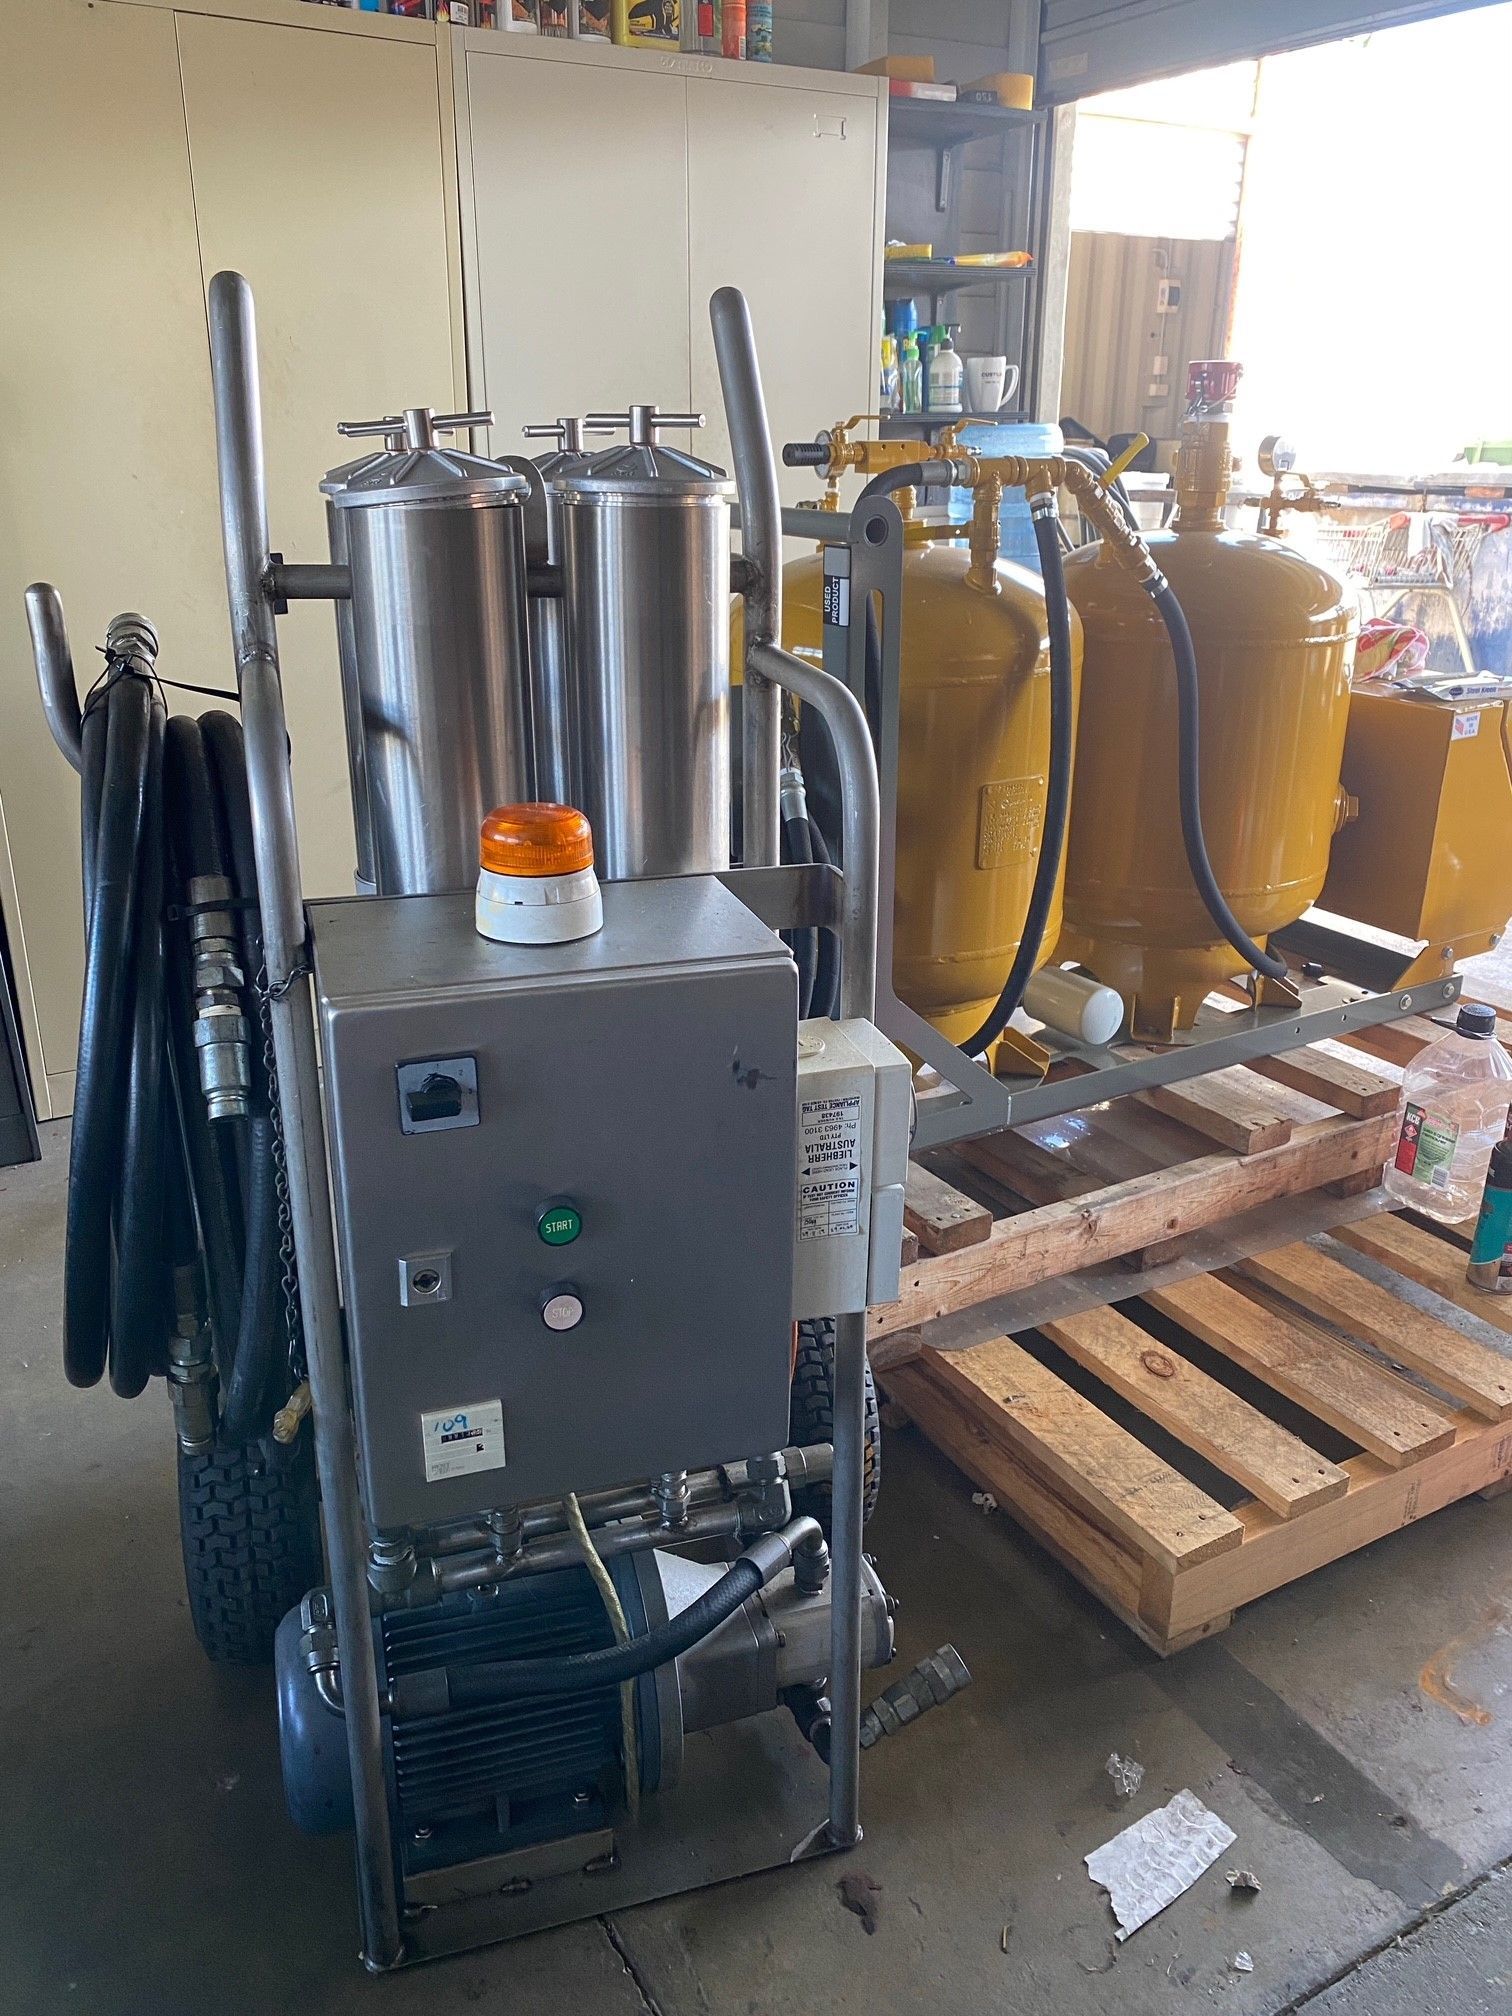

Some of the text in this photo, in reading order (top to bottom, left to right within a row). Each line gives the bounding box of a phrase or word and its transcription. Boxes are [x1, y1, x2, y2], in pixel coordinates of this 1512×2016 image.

[824, 586, 832, 612] USED
[829, 1099, 860, 1108] APPLIANCE
[804, 1126, 823, 1134] 3100
[824, 1124, 843, 1132] 4963
[804, 1139, 856, 1153] AUSTRALIA
[808, 1149, 852, 1163] LIEBHERR
[803, 1181, 855, 1194] CAUTION
[545, 1219, 573, 1234] START
[551, 1307, 574, 1320] STOP
[434, 1413, 468, 1432] 109
